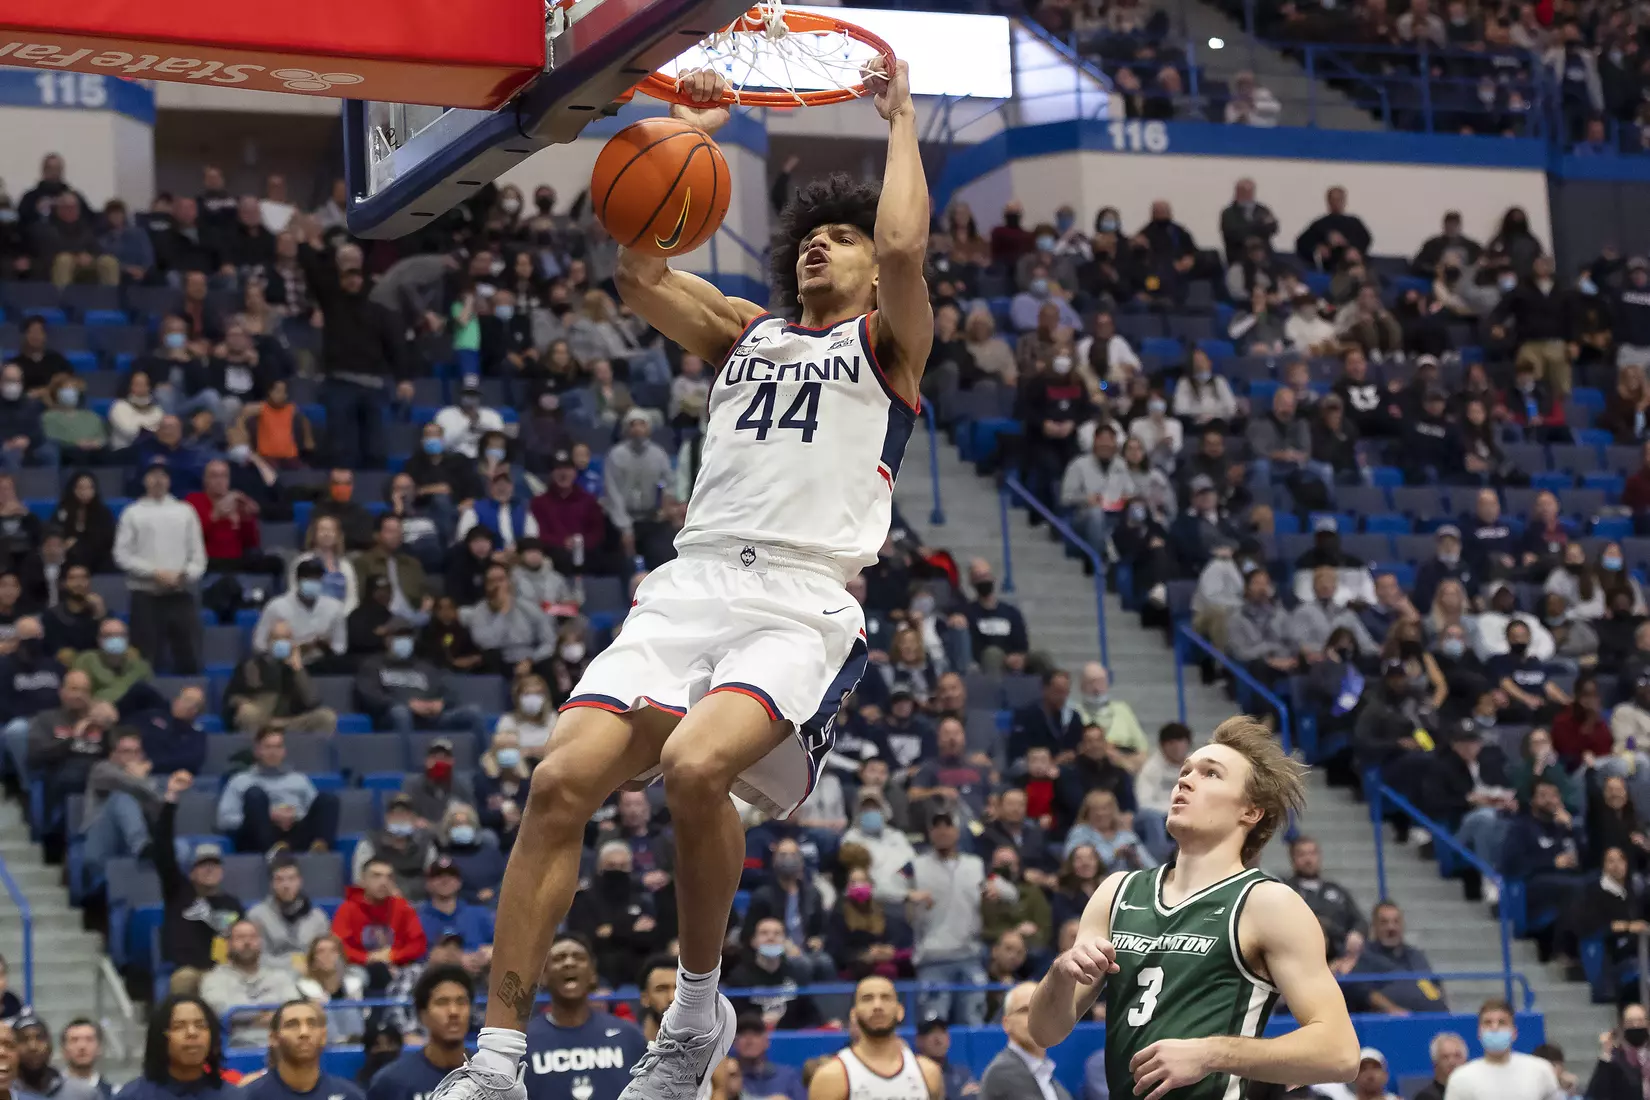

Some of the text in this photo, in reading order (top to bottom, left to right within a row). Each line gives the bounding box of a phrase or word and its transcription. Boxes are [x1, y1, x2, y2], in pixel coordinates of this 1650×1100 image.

[36, 73, 108, 104] 115
[1108, 120, 1169, 150] 116
[725, 356, 860, 386] UCONN
[735, 382, 822, 442] 44
[1111, 932, 1214, 953] BINGAMTON
[1127, 966, 1164, 1026] 3
[532, 1045, 624, 1074] UCONN
